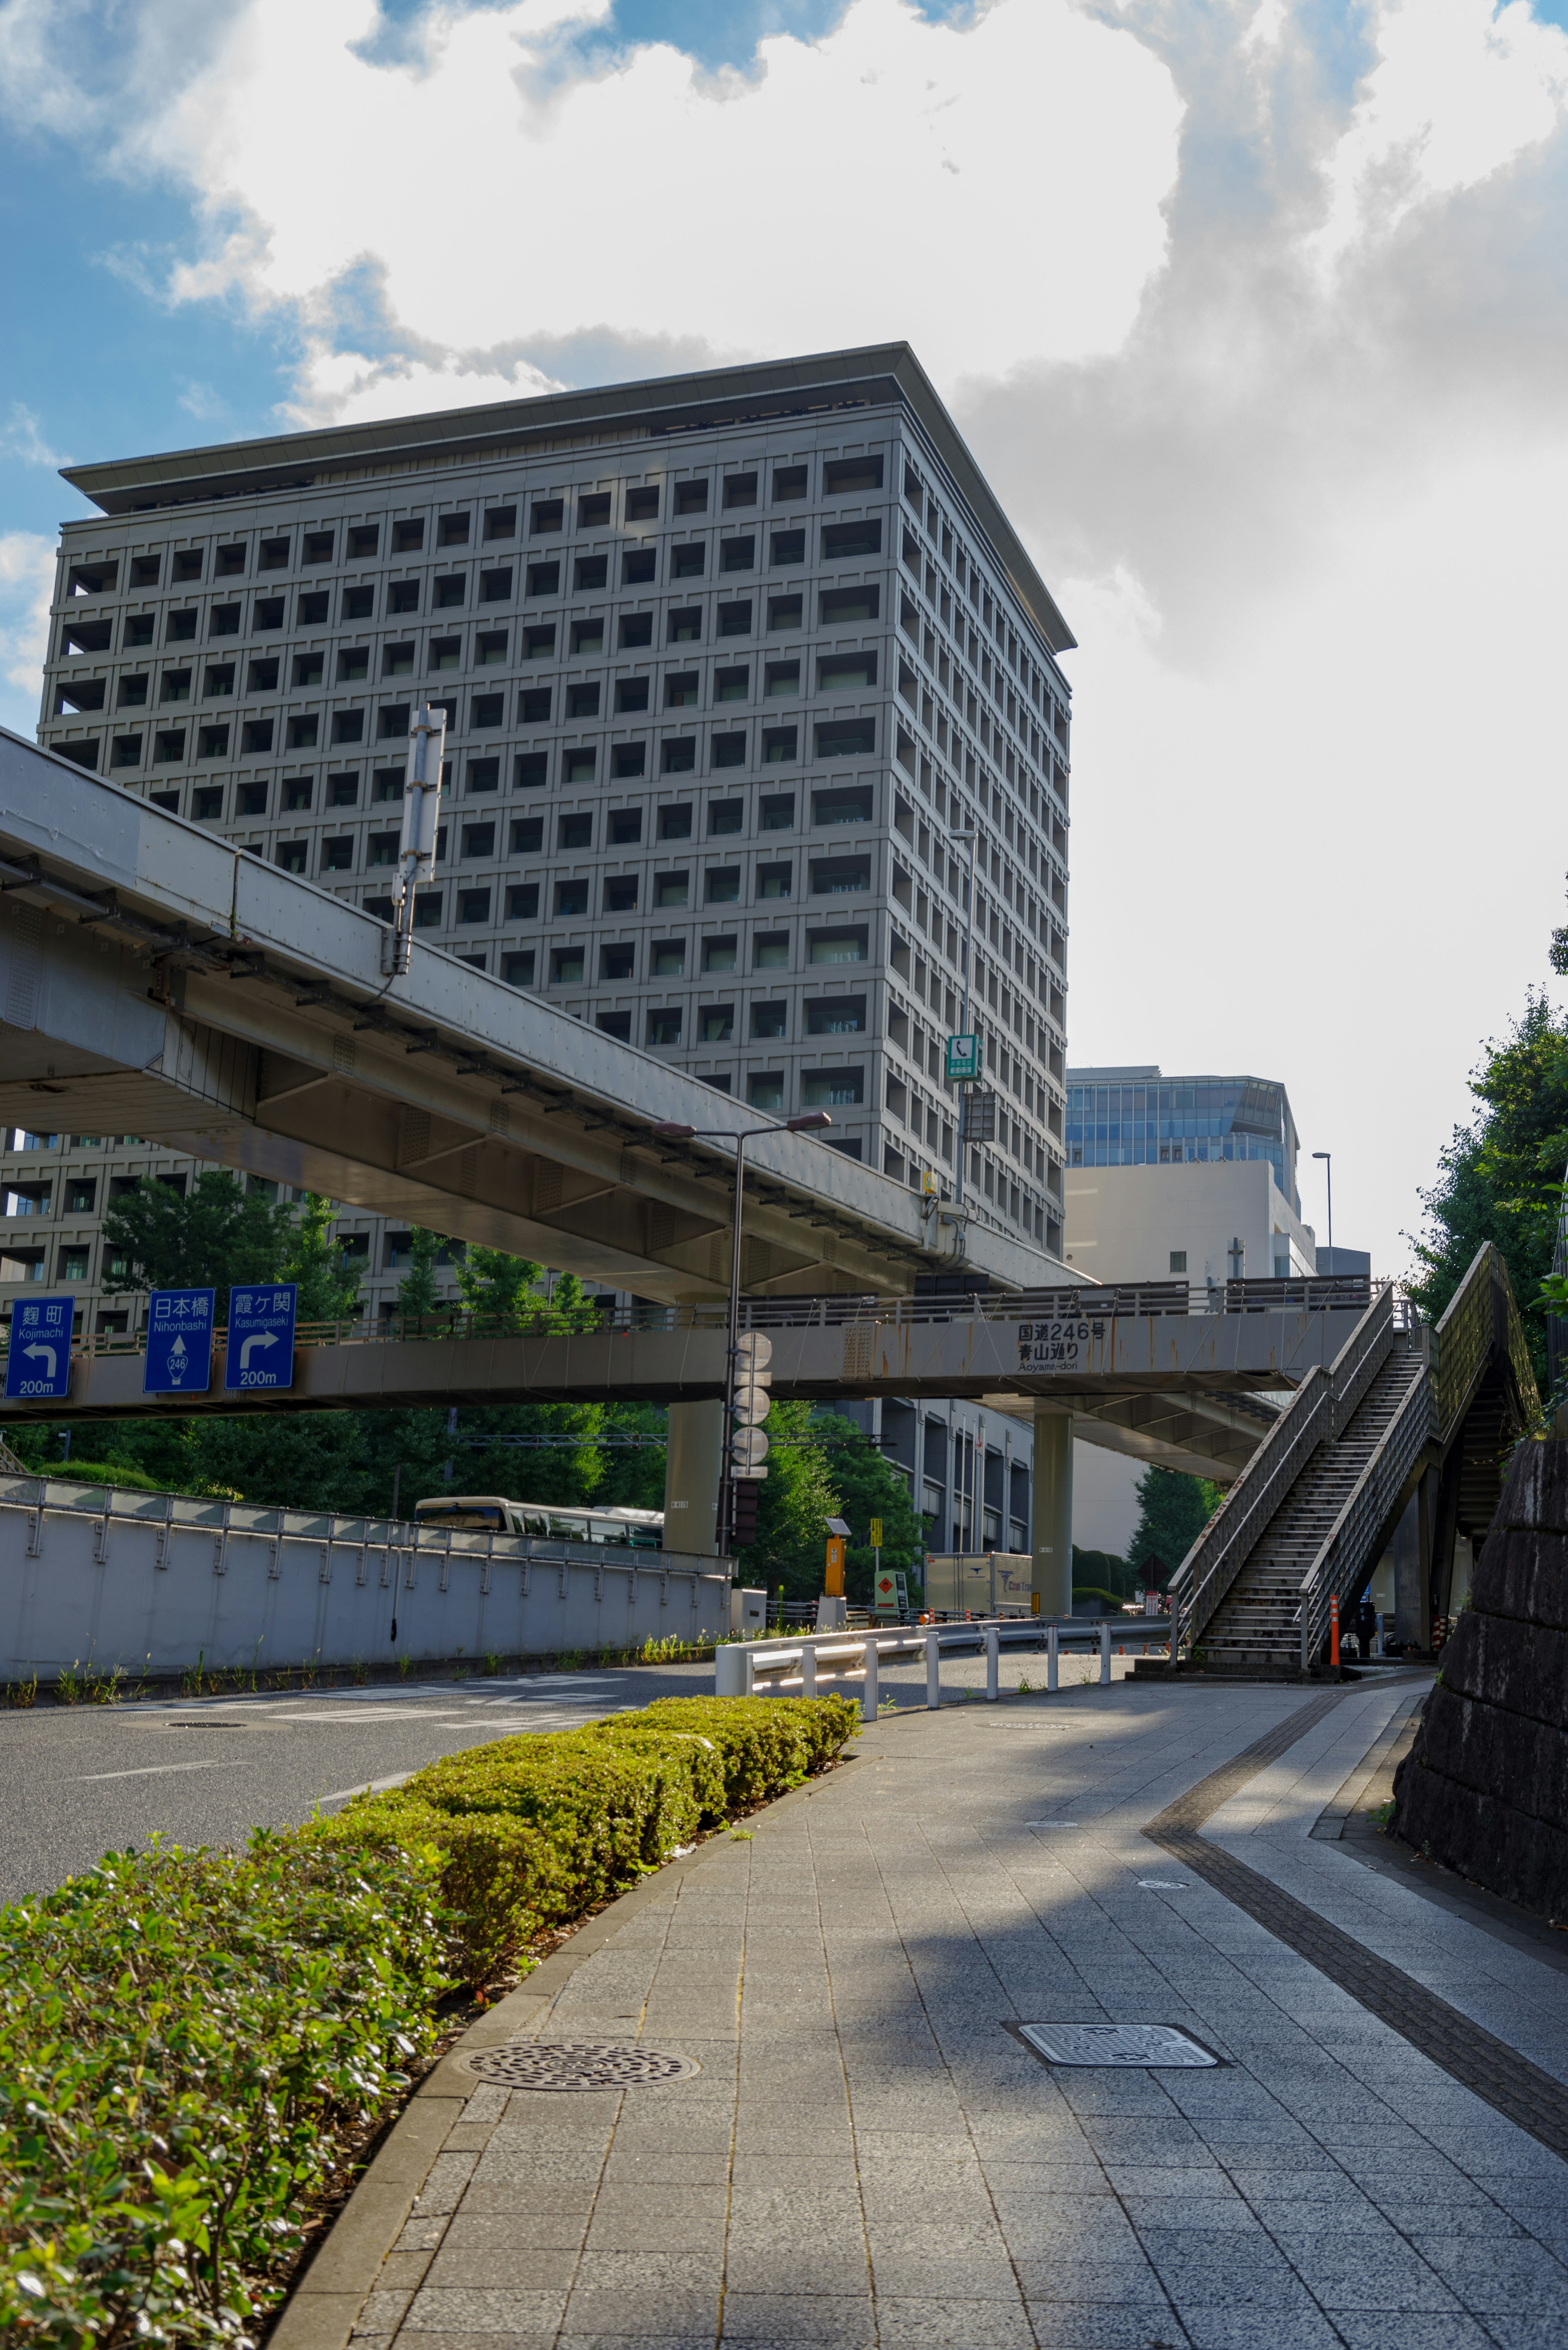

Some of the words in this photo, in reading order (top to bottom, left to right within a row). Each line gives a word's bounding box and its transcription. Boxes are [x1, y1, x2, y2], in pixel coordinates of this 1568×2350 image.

[155, 1297, 209, 1318] 日本橋
[154, 1320, 207, 1332] Nihonbashi
[235, 1315, 288, 1329] Kasumigaseki
[19, 1327, 63, 1340] Kojimachi
[1019, 1322, 1105, 1341] 国道246号
[1018, 1342, 1078, 1361] 青山通り
[170, 1359, 185, 1370] 246
[1018, 1361, 1077, 1373] Aoyama-dori
[241, 1371, 276, 1385] 200m
[20, 1380, 53, 1394] 200m
